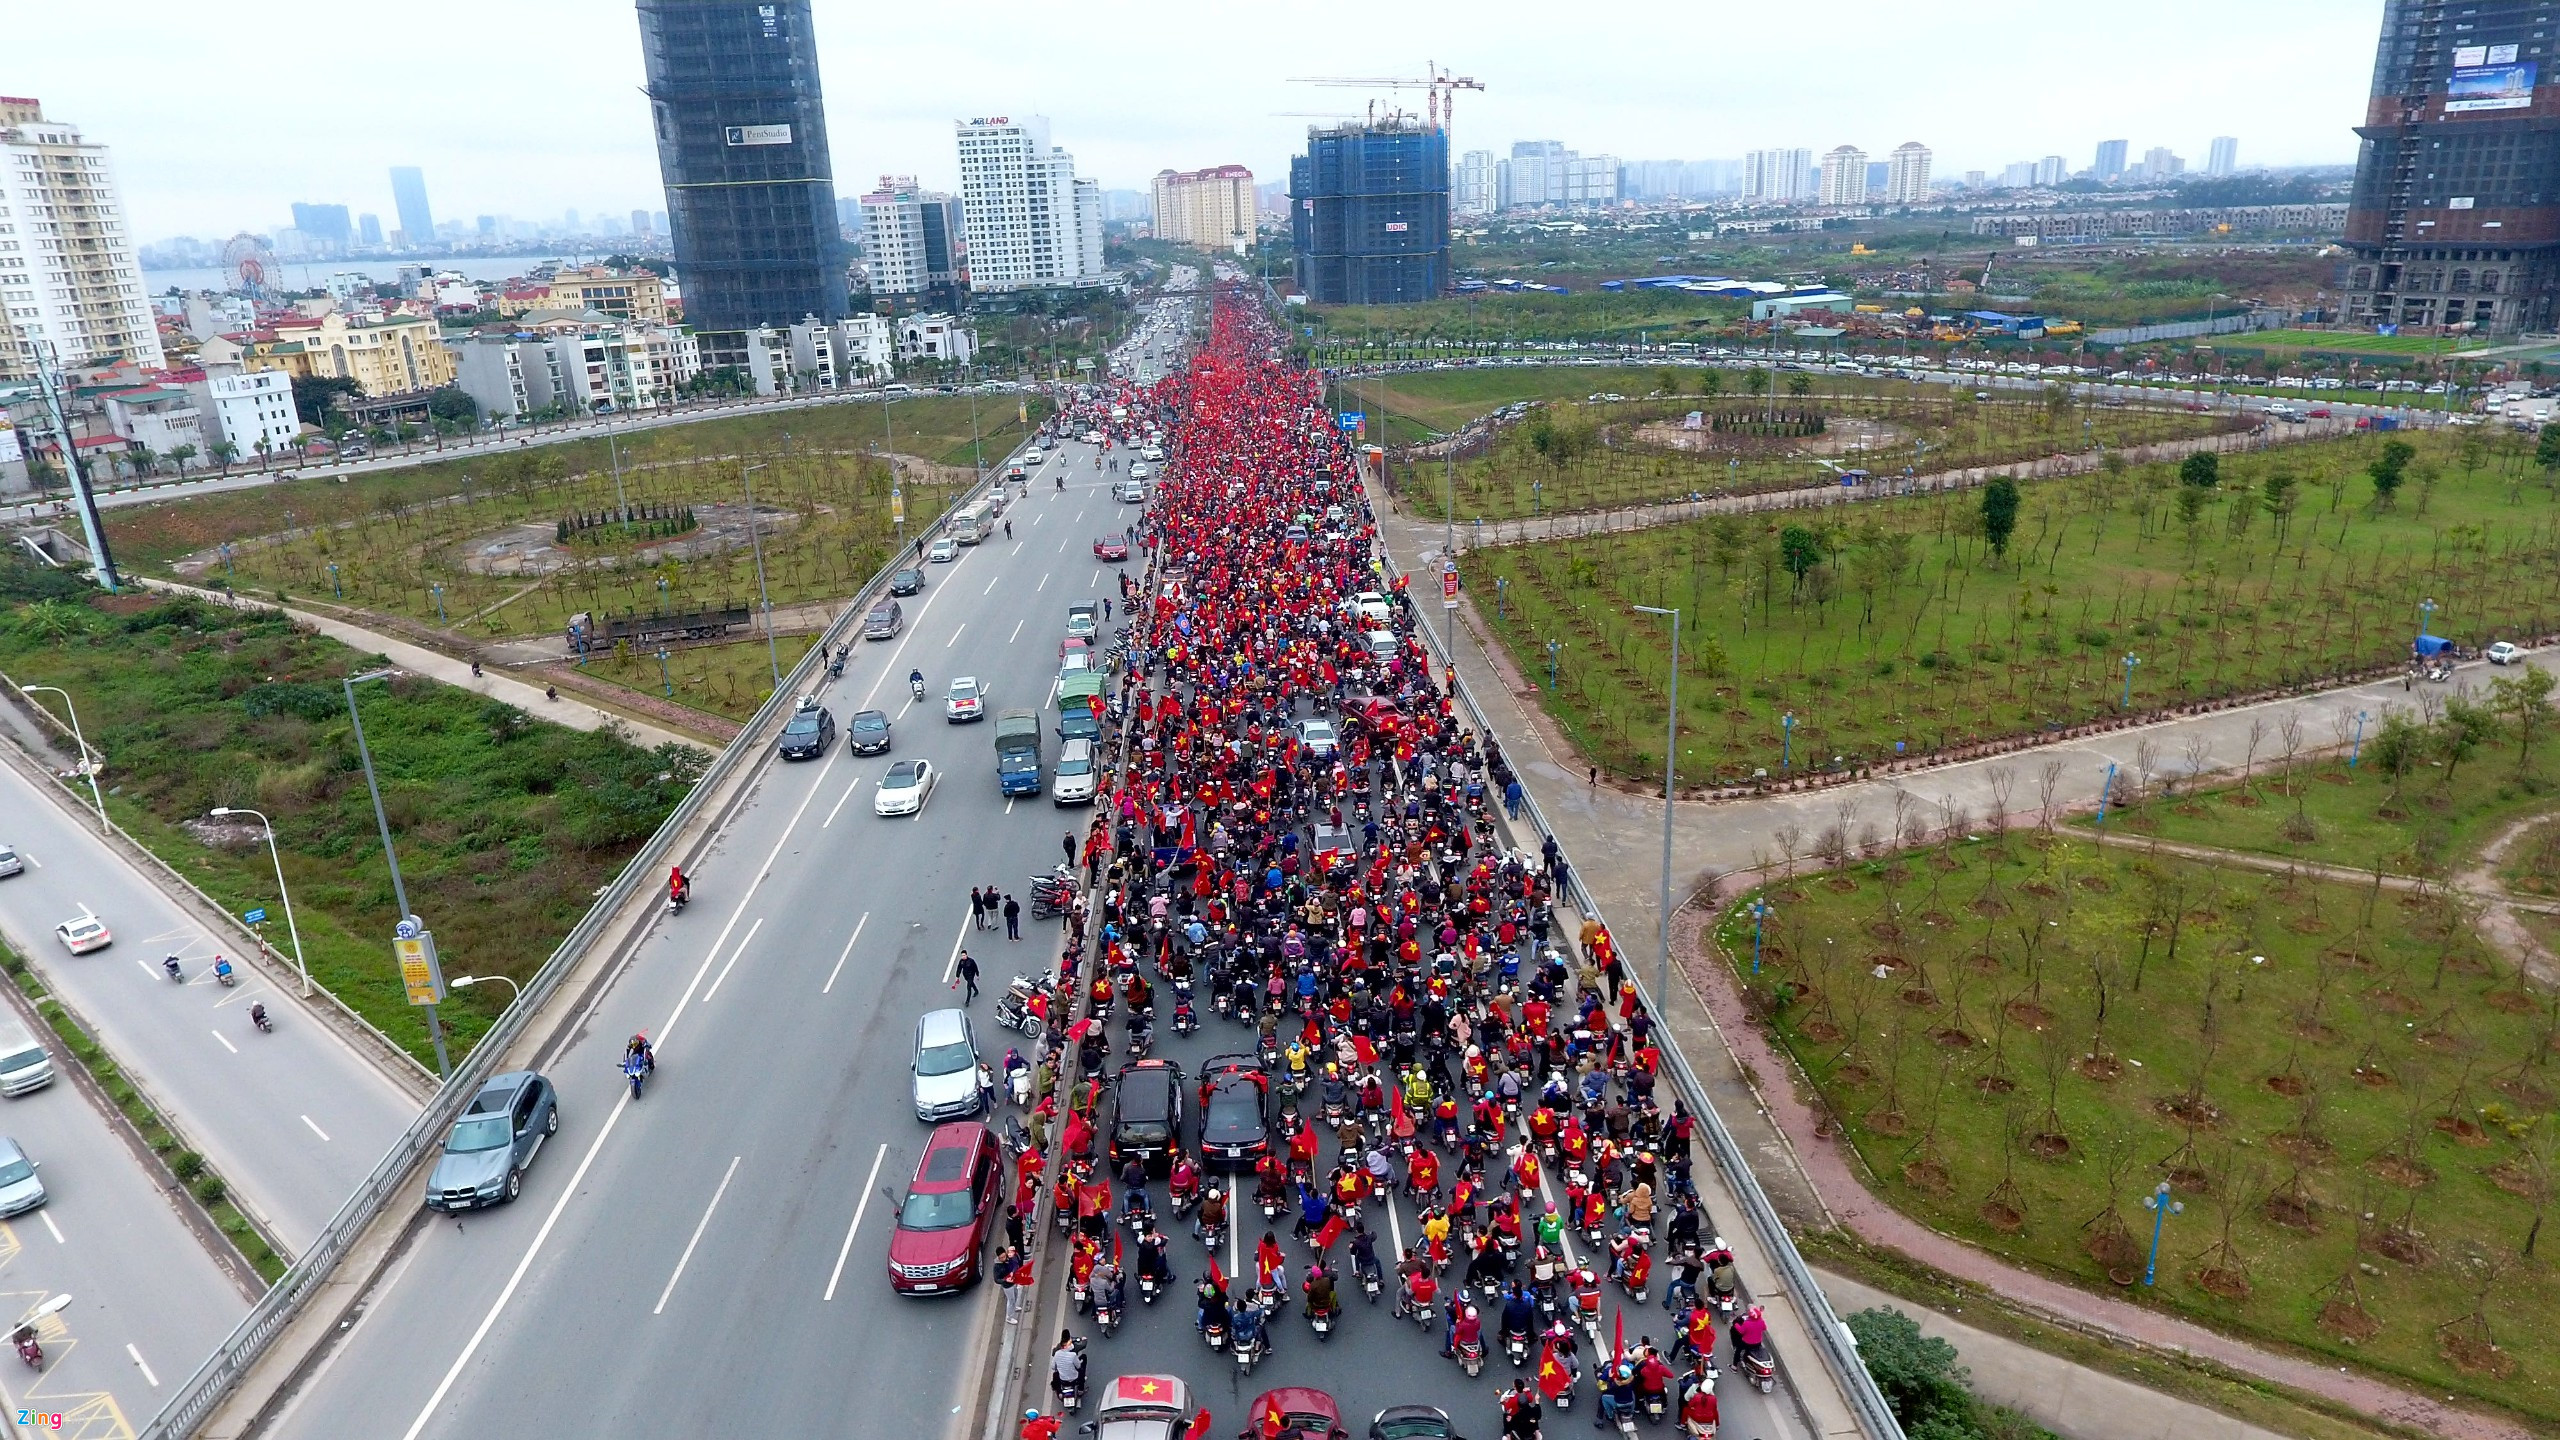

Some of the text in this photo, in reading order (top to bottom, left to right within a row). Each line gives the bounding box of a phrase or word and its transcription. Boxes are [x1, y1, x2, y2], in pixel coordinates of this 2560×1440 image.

[985, 116, 1009, 126] LAND
[746, 128, 788, 139] PentStudio
[1387, 223, 1407, 231] UDIC
